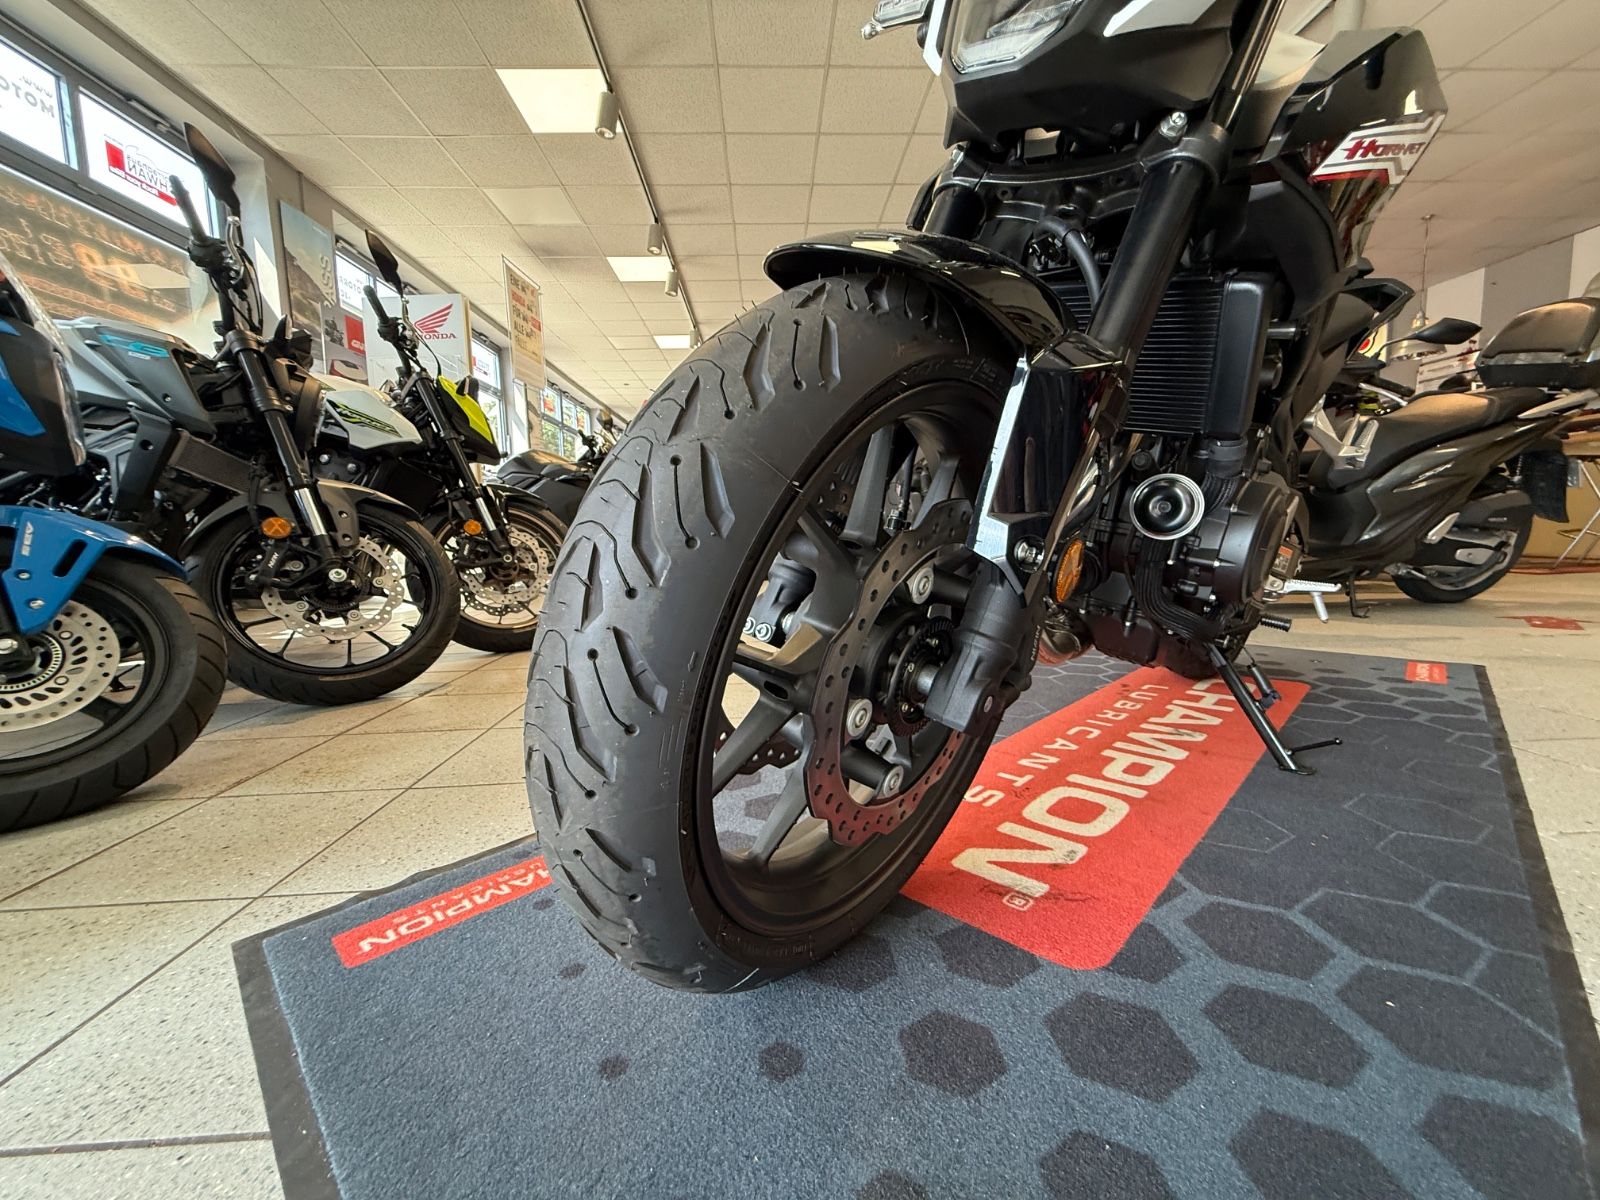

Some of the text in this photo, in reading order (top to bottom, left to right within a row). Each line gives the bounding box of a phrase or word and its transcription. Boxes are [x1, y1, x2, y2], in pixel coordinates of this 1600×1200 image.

[1340, 138, 1426, 160] HORNET
[951, 678, 1263, 898] CHAMPION
[963, 684, 1169, 807] LUBRICANTS
[355, 867, 550, 956] HAMPION
